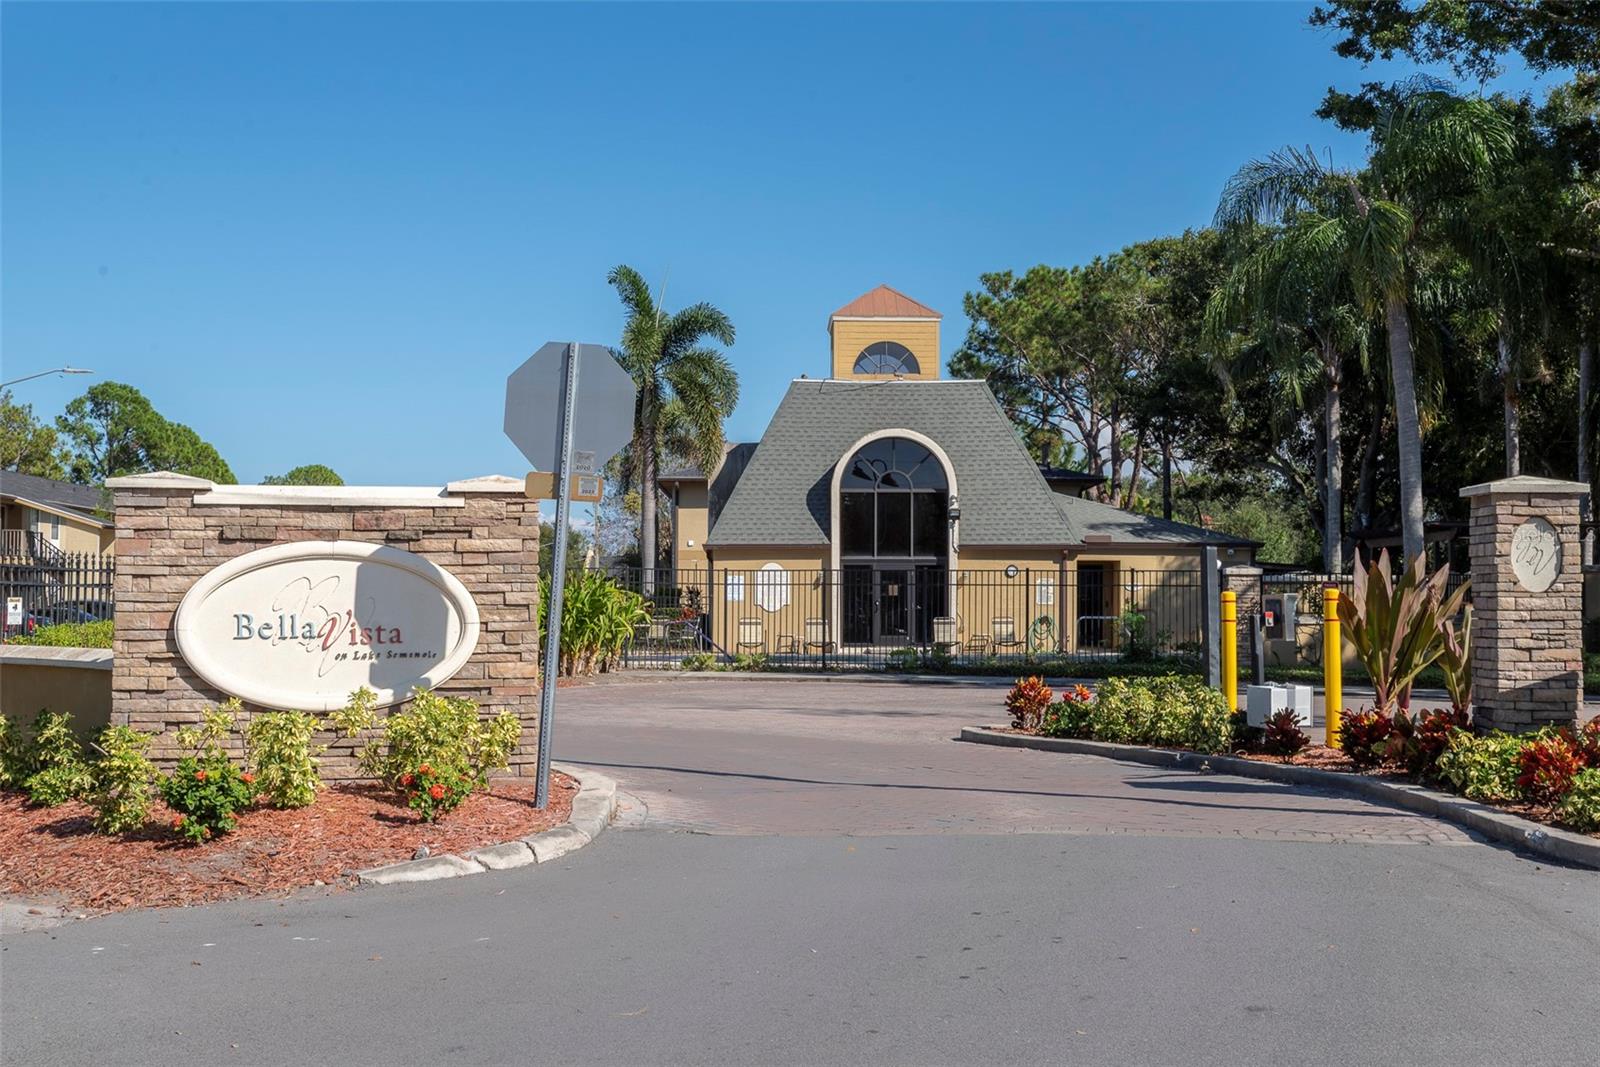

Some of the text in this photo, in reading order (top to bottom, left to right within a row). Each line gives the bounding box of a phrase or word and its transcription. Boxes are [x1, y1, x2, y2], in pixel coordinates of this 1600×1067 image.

[233, 609, 403, 651] Bella Vista
[334, 653, 348, 661] on
[353, 650, 381, 661] Lake
